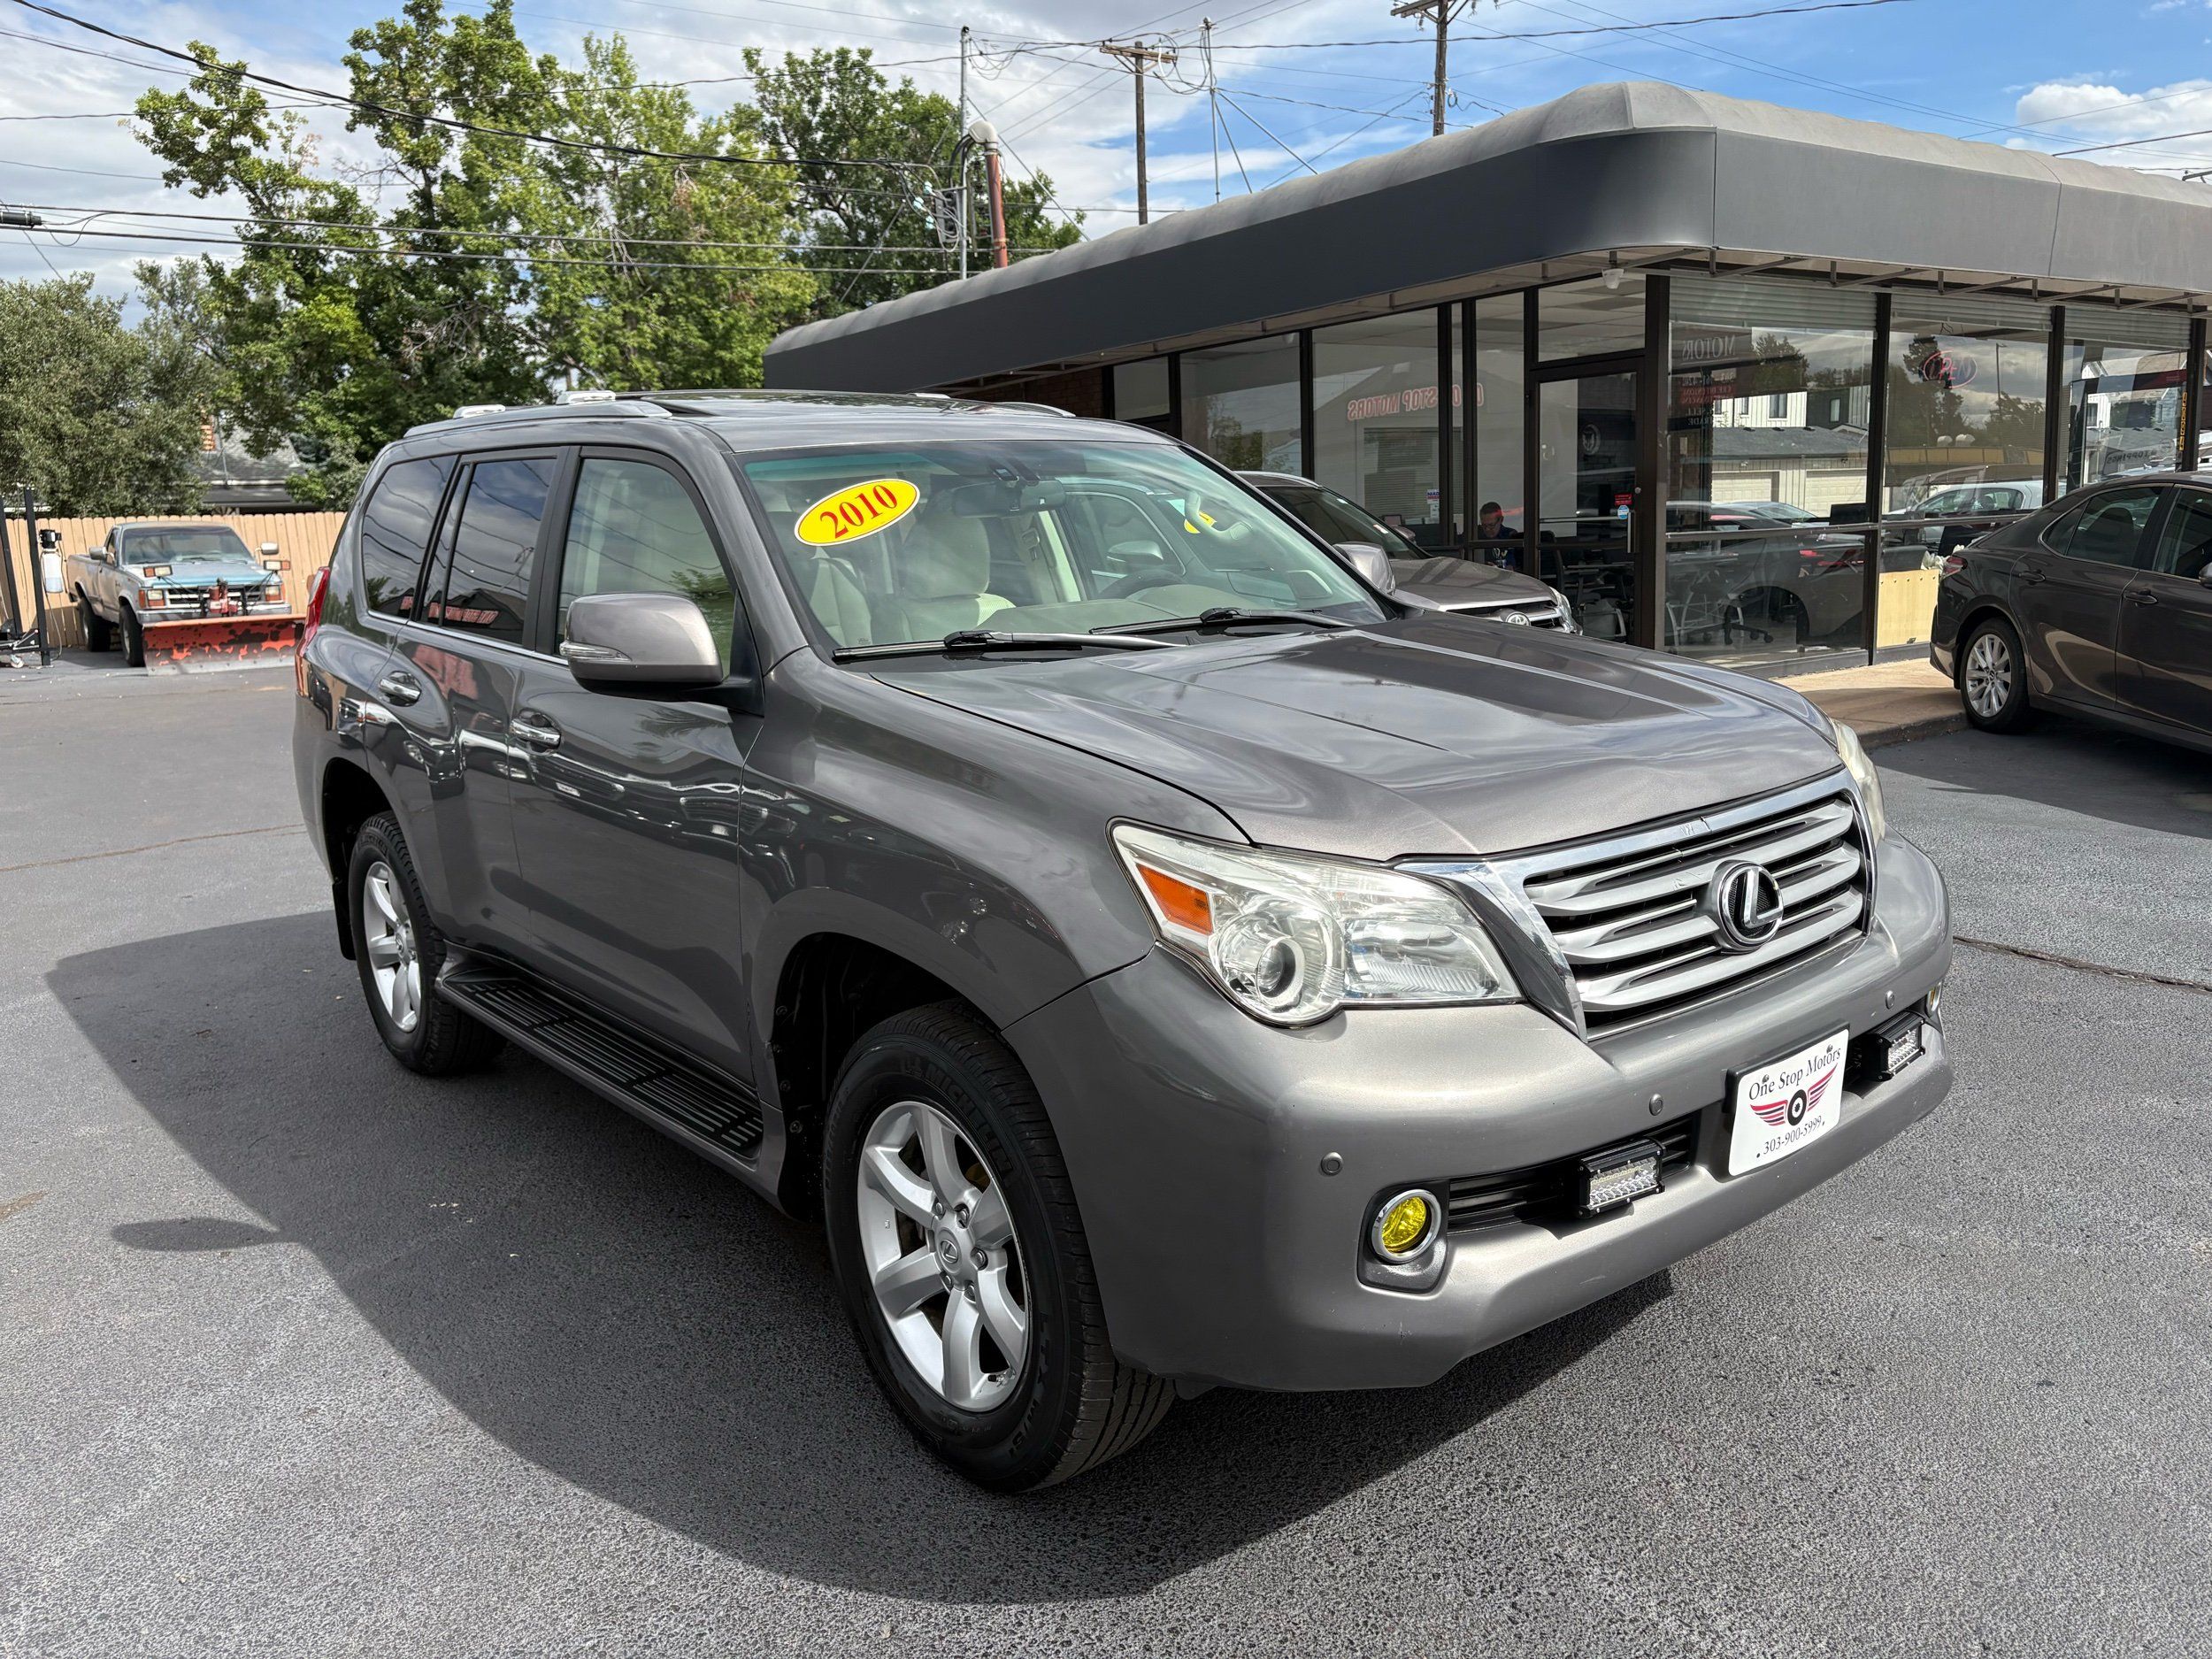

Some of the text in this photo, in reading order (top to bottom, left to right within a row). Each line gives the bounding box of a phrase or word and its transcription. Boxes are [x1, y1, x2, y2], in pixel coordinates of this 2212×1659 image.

[819, 484, 898, 539] 2010
[1748, 1048, 1841, 1101] One Stop Motors
[925, 1061, 1013, 1172] MICHELIN
[1763, 1115, 1822, 1155] 303-900-5999
